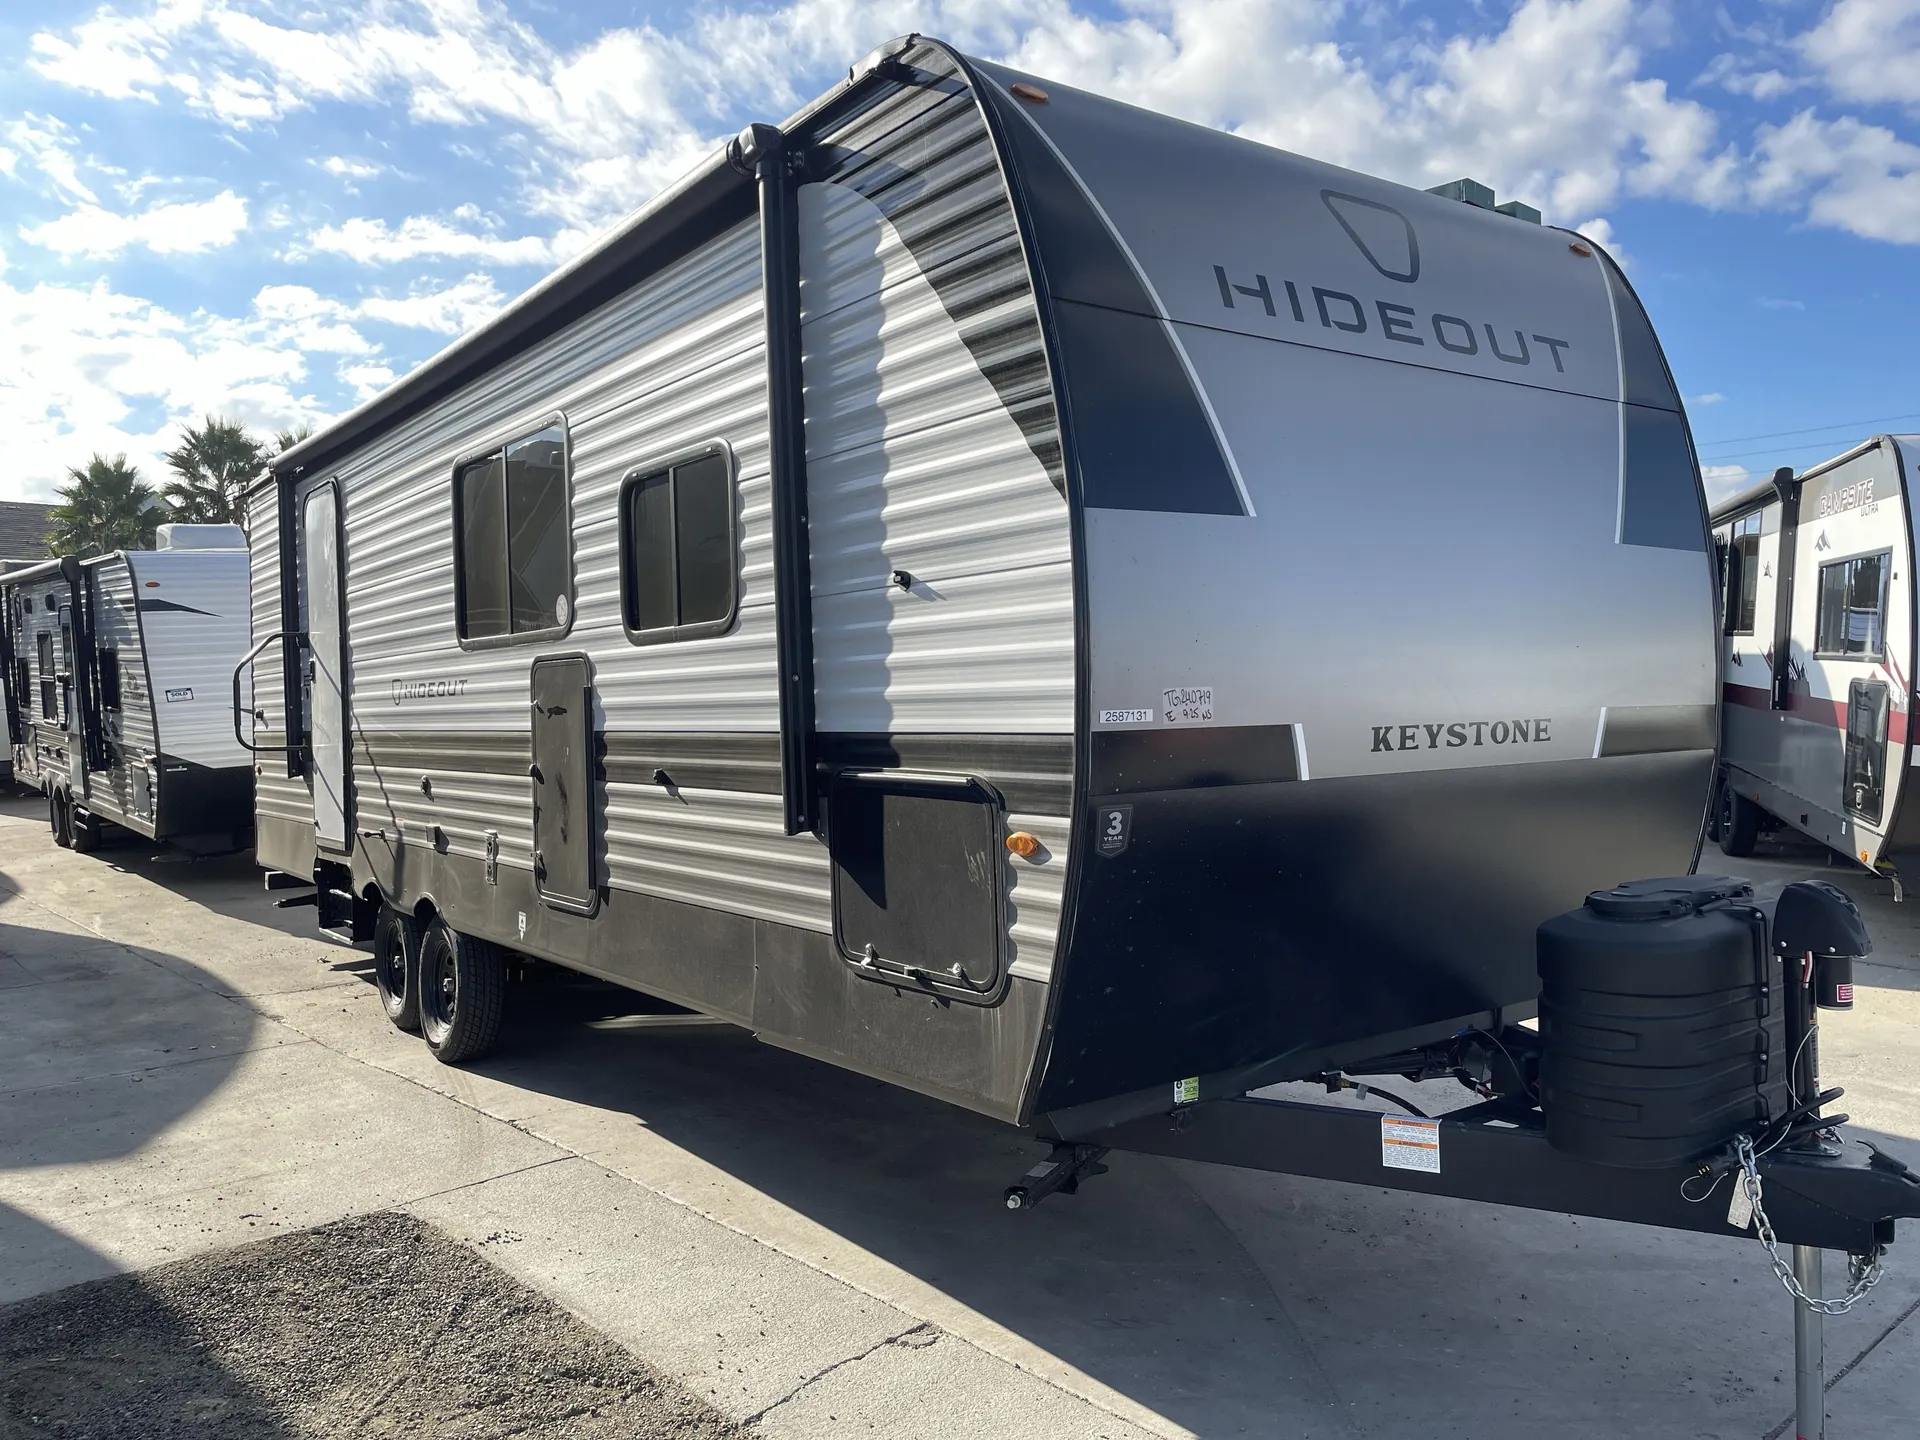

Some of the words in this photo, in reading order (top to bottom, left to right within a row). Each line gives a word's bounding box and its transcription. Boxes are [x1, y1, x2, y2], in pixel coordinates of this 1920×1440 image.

[1212, 264, 1570, 373] HIDEOUT
[1820, 478, 1874, 517] CAMPSITE
[404, 679, 468, 699] HIDEOUT
[1105, 711, 1147, 722] 2587131
[1370, 718, 1552, 752] KEYSTONE
[1106, 811, 1123, 835] 3
